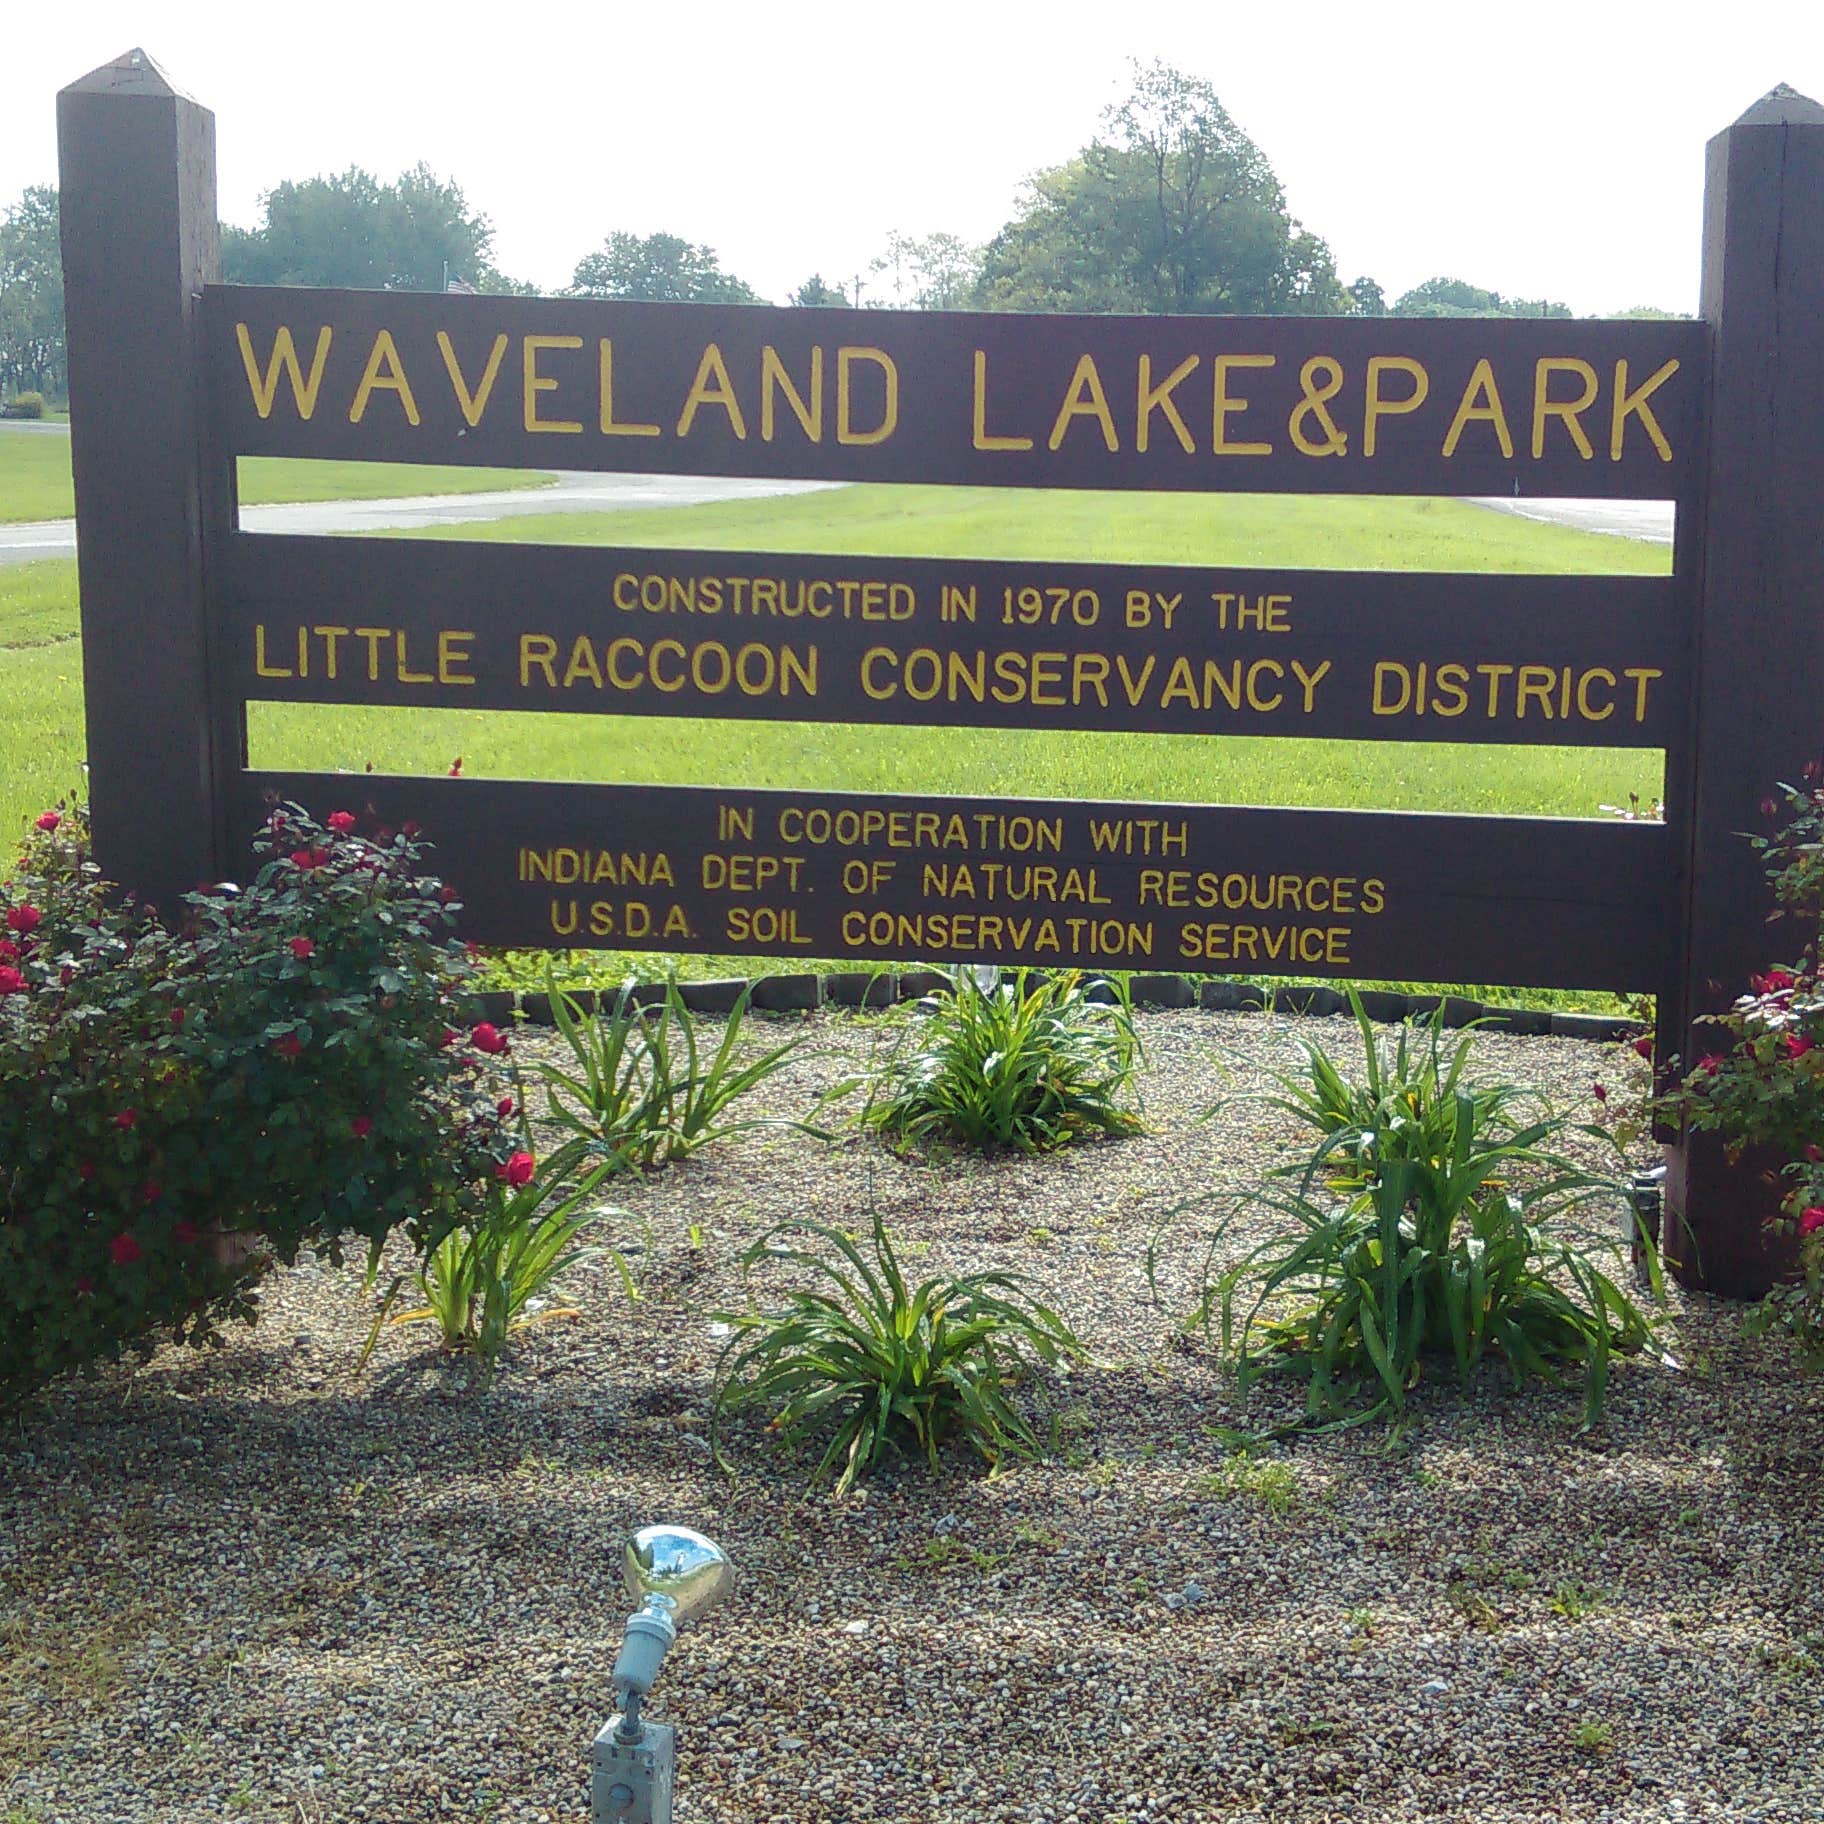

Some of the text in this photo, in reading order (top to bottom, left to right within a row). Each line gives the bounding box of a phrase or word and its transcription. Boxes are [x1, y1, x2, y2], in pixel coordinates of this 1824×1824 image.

[237, 324, 898, 444] WAVELAND
[613, 574, 1293, 633] CONSTRUCTED IN 1970 BY THE
[256, 625, 1661, 721] LITTLE RACCOON CONSERVANCY DISTRICT
[719, 806, 1187, 857] IN COOPERATION WITH
[518, 847, 675, 887] INDIANA
[843, 860, 896, 895] OF
[923, 863, 1111, 904] NATURAL
[1139, 869, 1384, 914] RESOURCES
[726, 907, 812, 944] SOIL
[842, 911, 1153, 954] CONSERVATION
[1181, 922, 1350, 964] SERVICE
